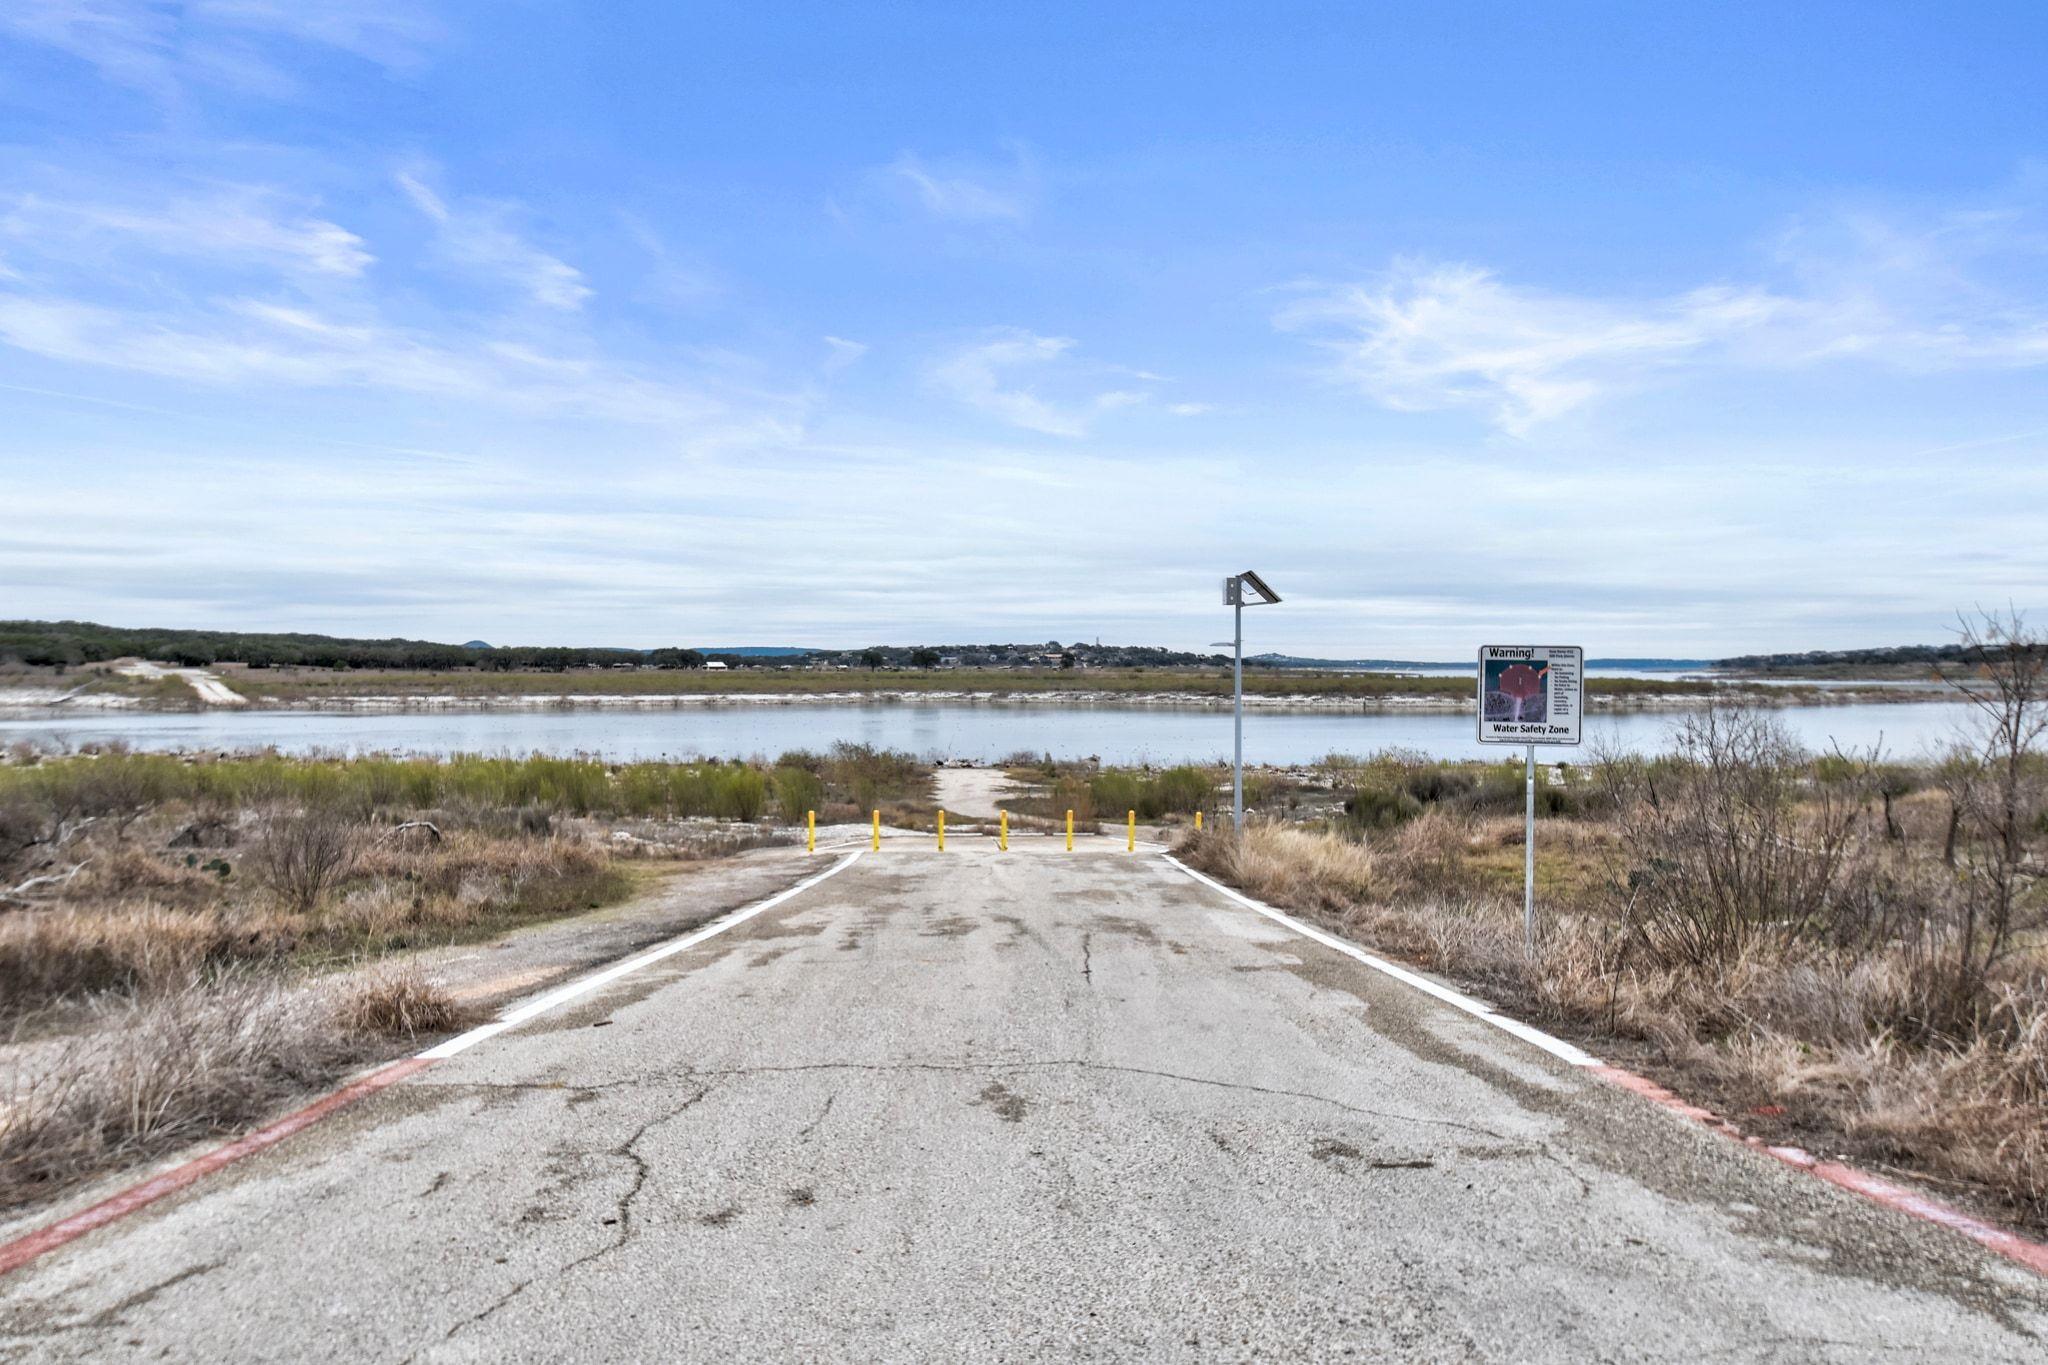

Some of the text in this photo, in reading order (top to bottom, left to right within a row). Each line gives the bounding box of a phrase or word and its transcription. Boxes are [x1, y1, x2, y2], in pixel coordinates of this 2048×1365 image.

[1489, 647, 1534, 660] Warning!
[1493, 724, 1569, 735] Water Safety Zone
